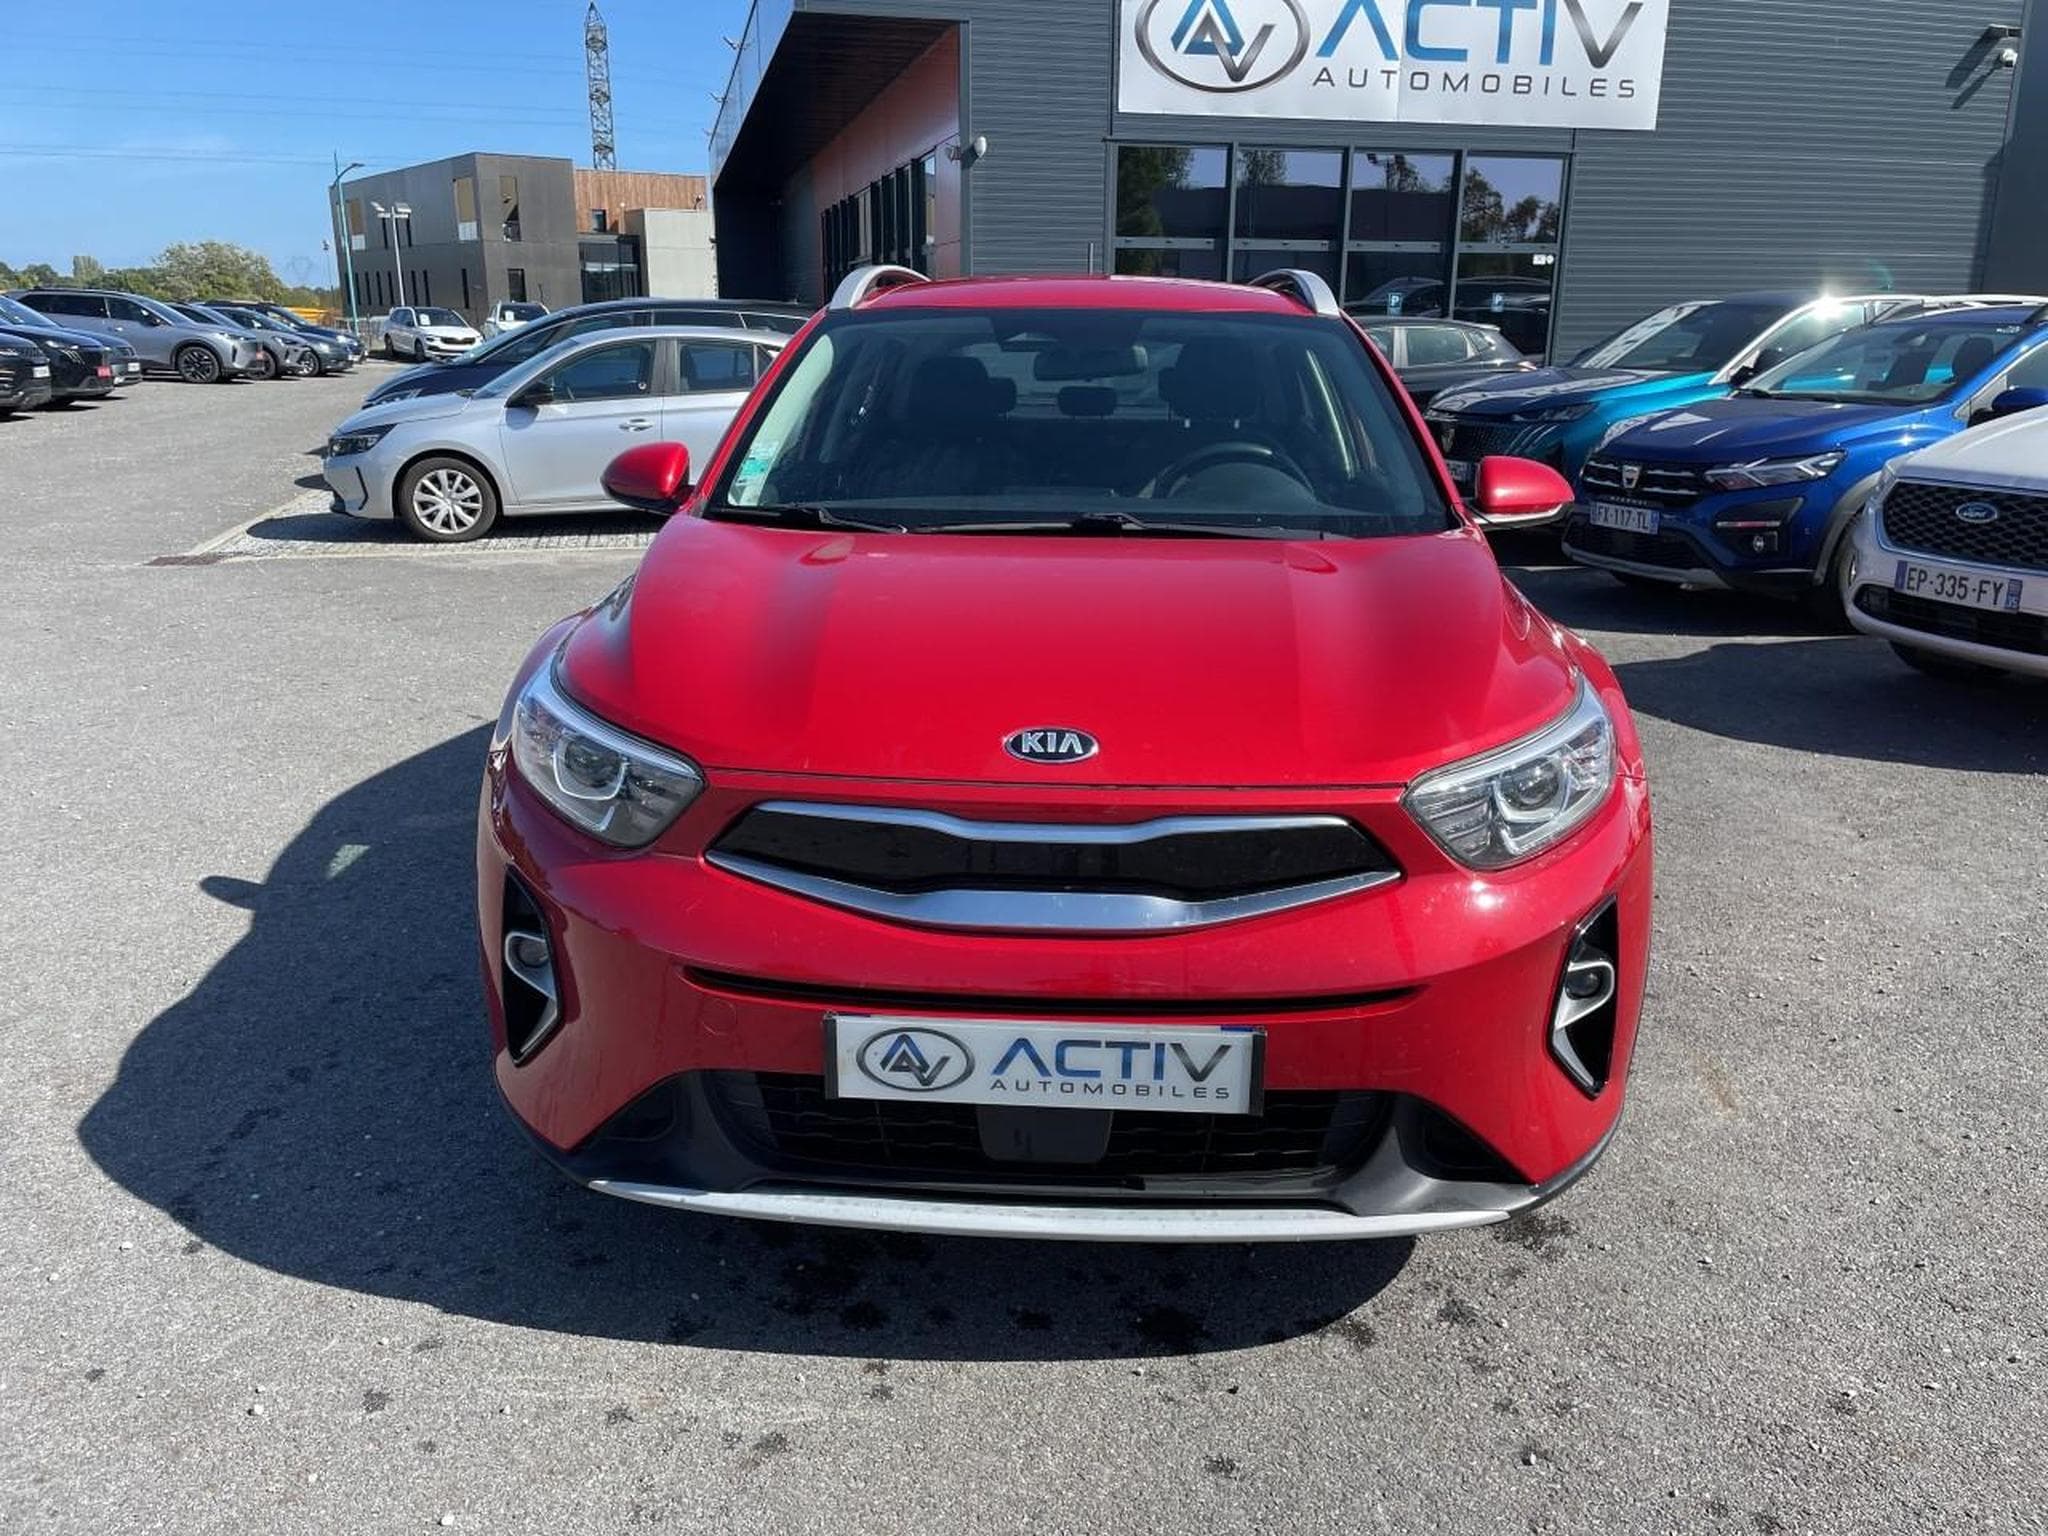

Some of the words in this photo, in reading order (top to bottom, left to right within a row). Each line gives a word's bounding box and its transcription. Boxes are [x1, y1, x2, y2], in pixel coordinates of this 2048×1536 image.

[1316, 0, 1643, 69] ACTIV
[1312, 67, 1635, 98] AUTOMOBILES
[1906, 567, 2003, 606] EP-335-FY
[1022, 732, 1083, 754] KIA
[991, 1037, 1232, 1083] ACTIV
[990, 1079, 1231, 1099] AUTOMOBILES
